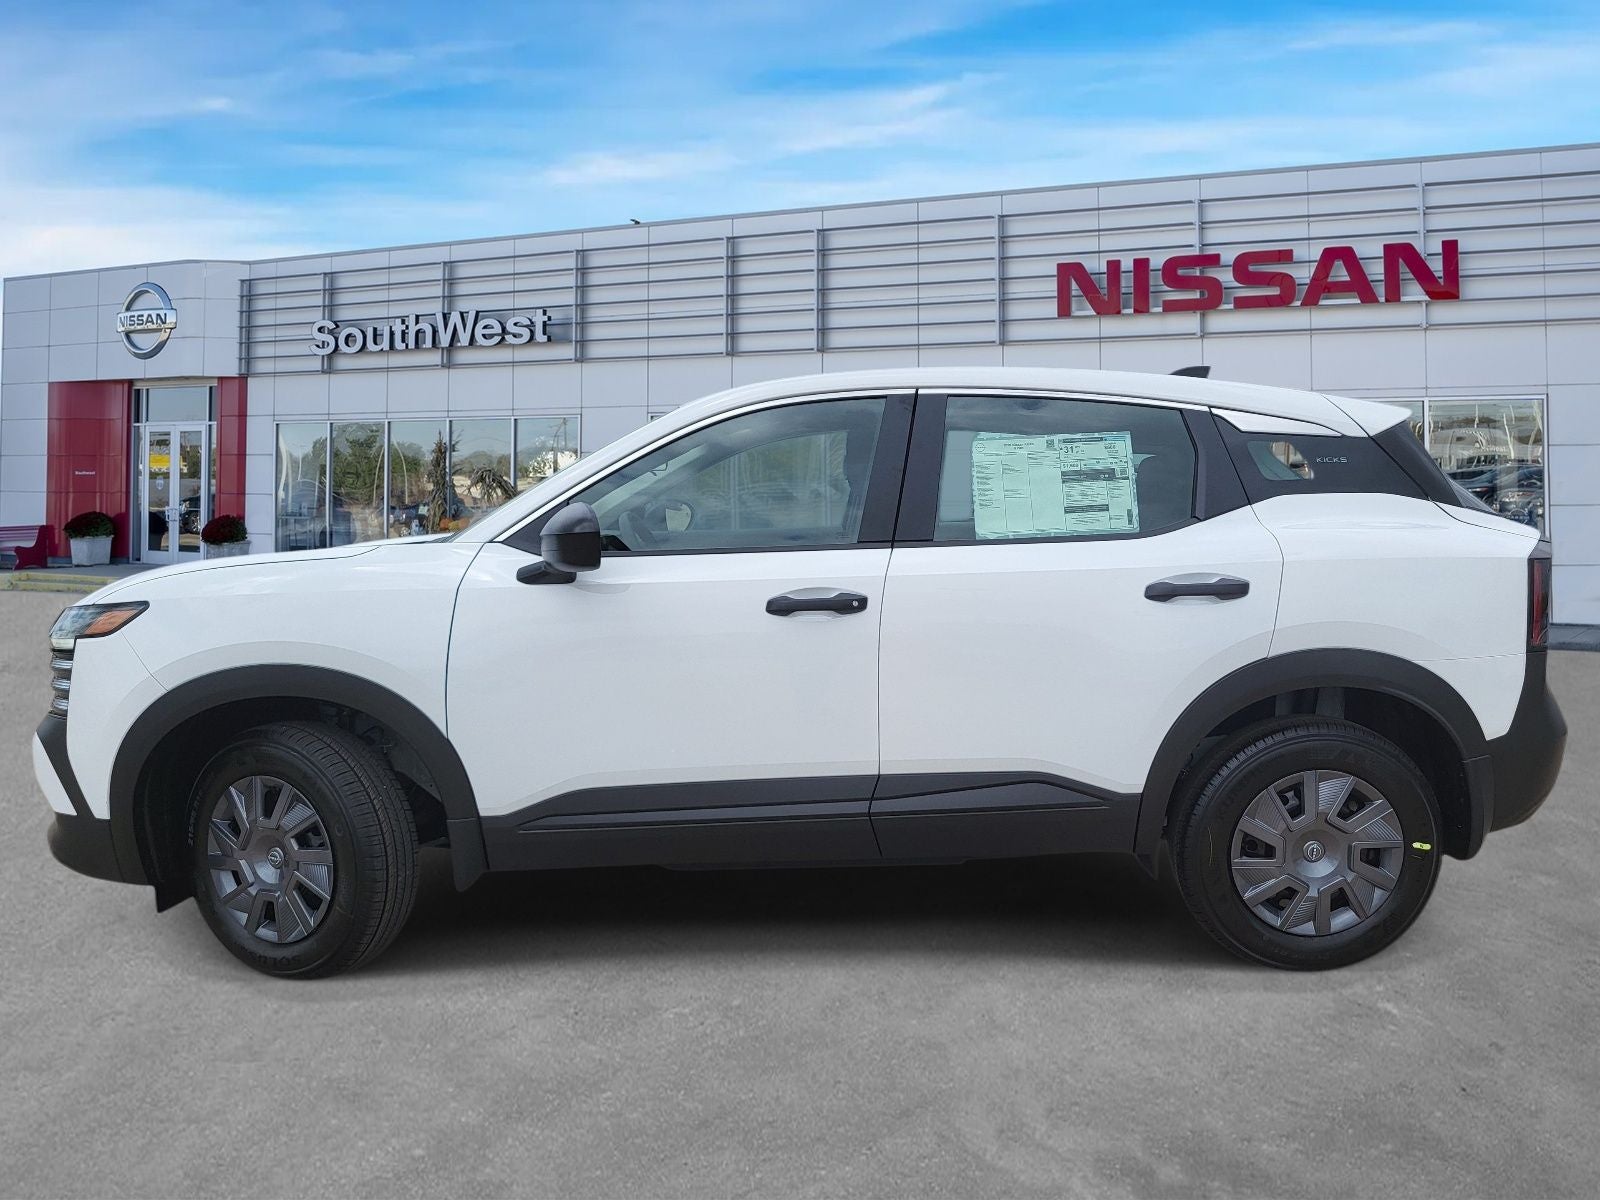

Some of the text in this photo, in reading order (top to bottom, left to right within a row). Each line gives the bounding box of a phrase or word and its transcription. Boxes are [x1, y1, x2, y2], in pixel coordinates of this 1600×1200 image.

[1056, 239, 1460, 318] NISSAN
[119, 313, 167, 328] NISSAN
[309, 309, 551, 356] SouthWest
